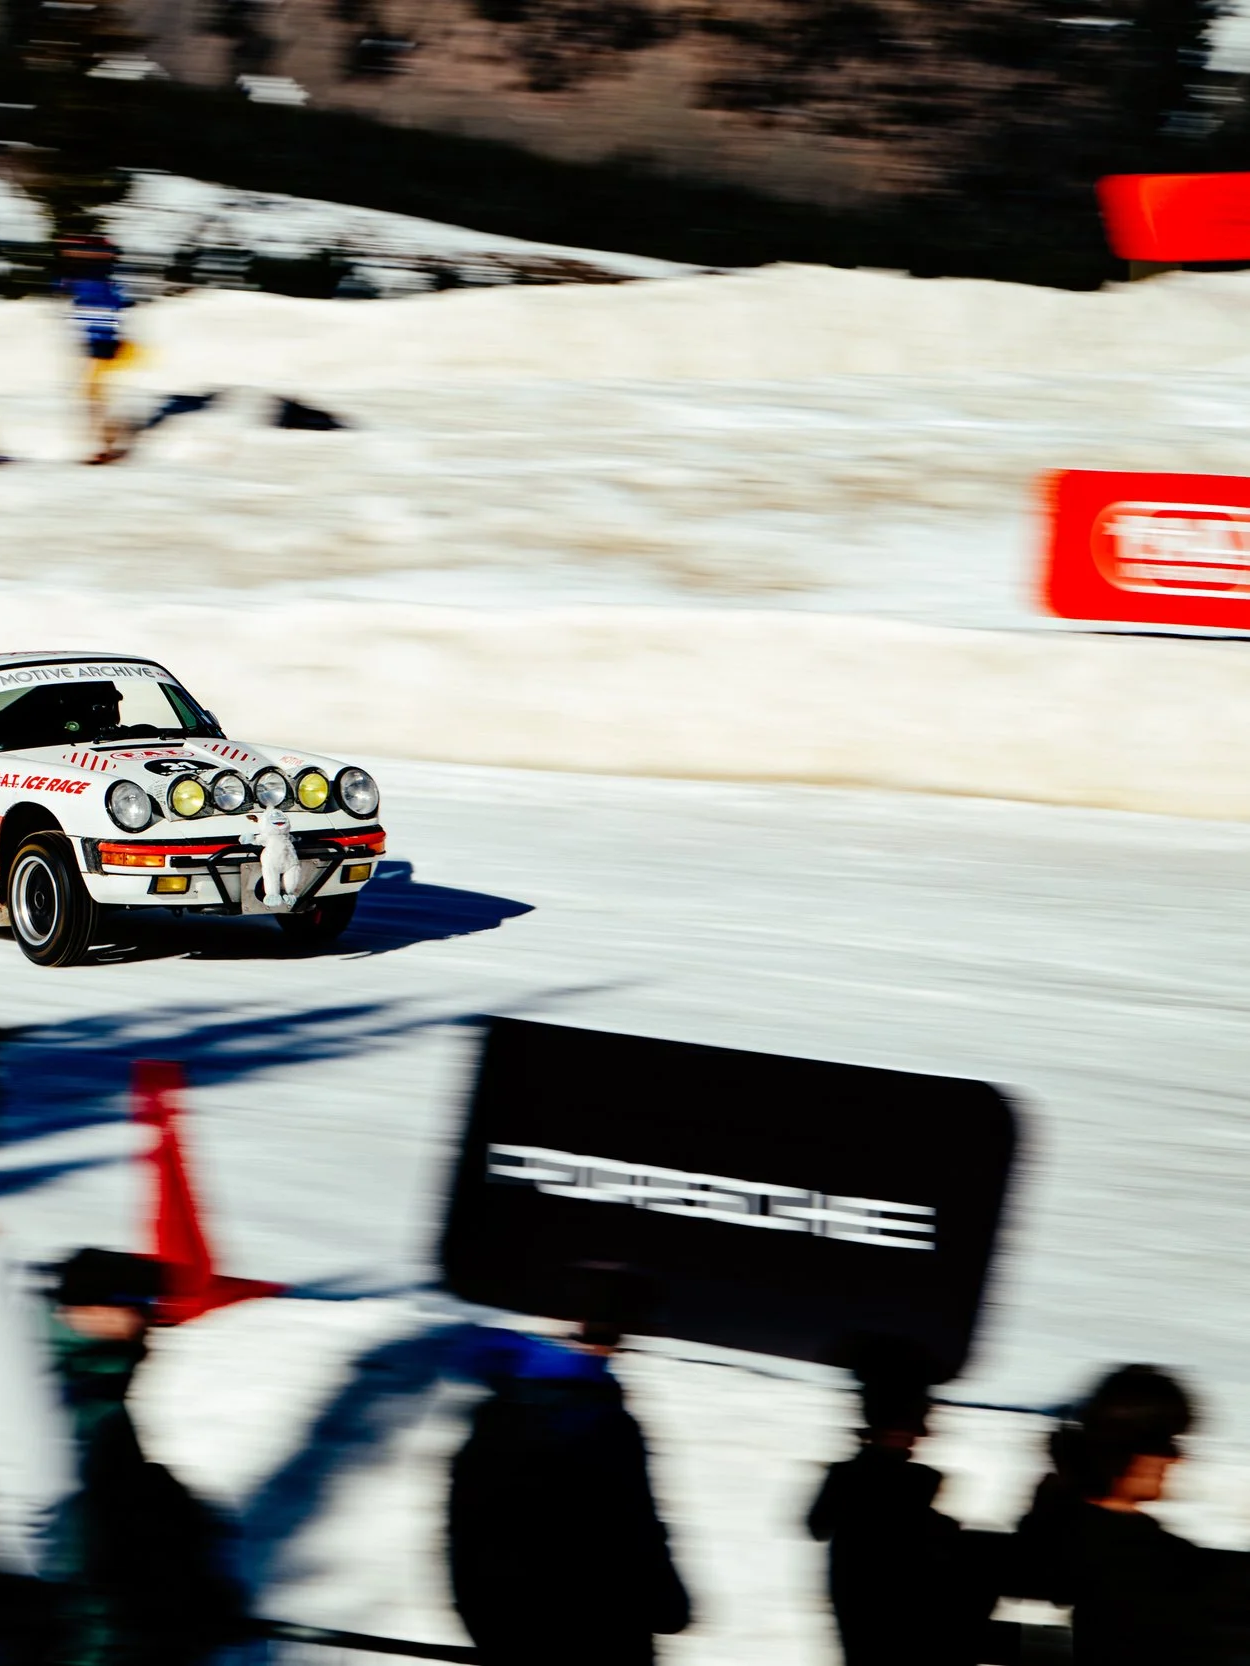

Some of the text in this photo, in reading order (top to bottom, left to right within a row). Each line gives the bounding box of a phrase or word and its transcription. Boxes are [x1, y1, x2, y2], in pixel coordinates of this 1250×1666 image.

[0, 667, 75, 687] MOTIVE
[78, 666, 156, 679] ARCHIVE
[161, 761, 199, 771] 21
[20, 775, 49, 791] ICE
[45, 778, 92, 795] RACE
